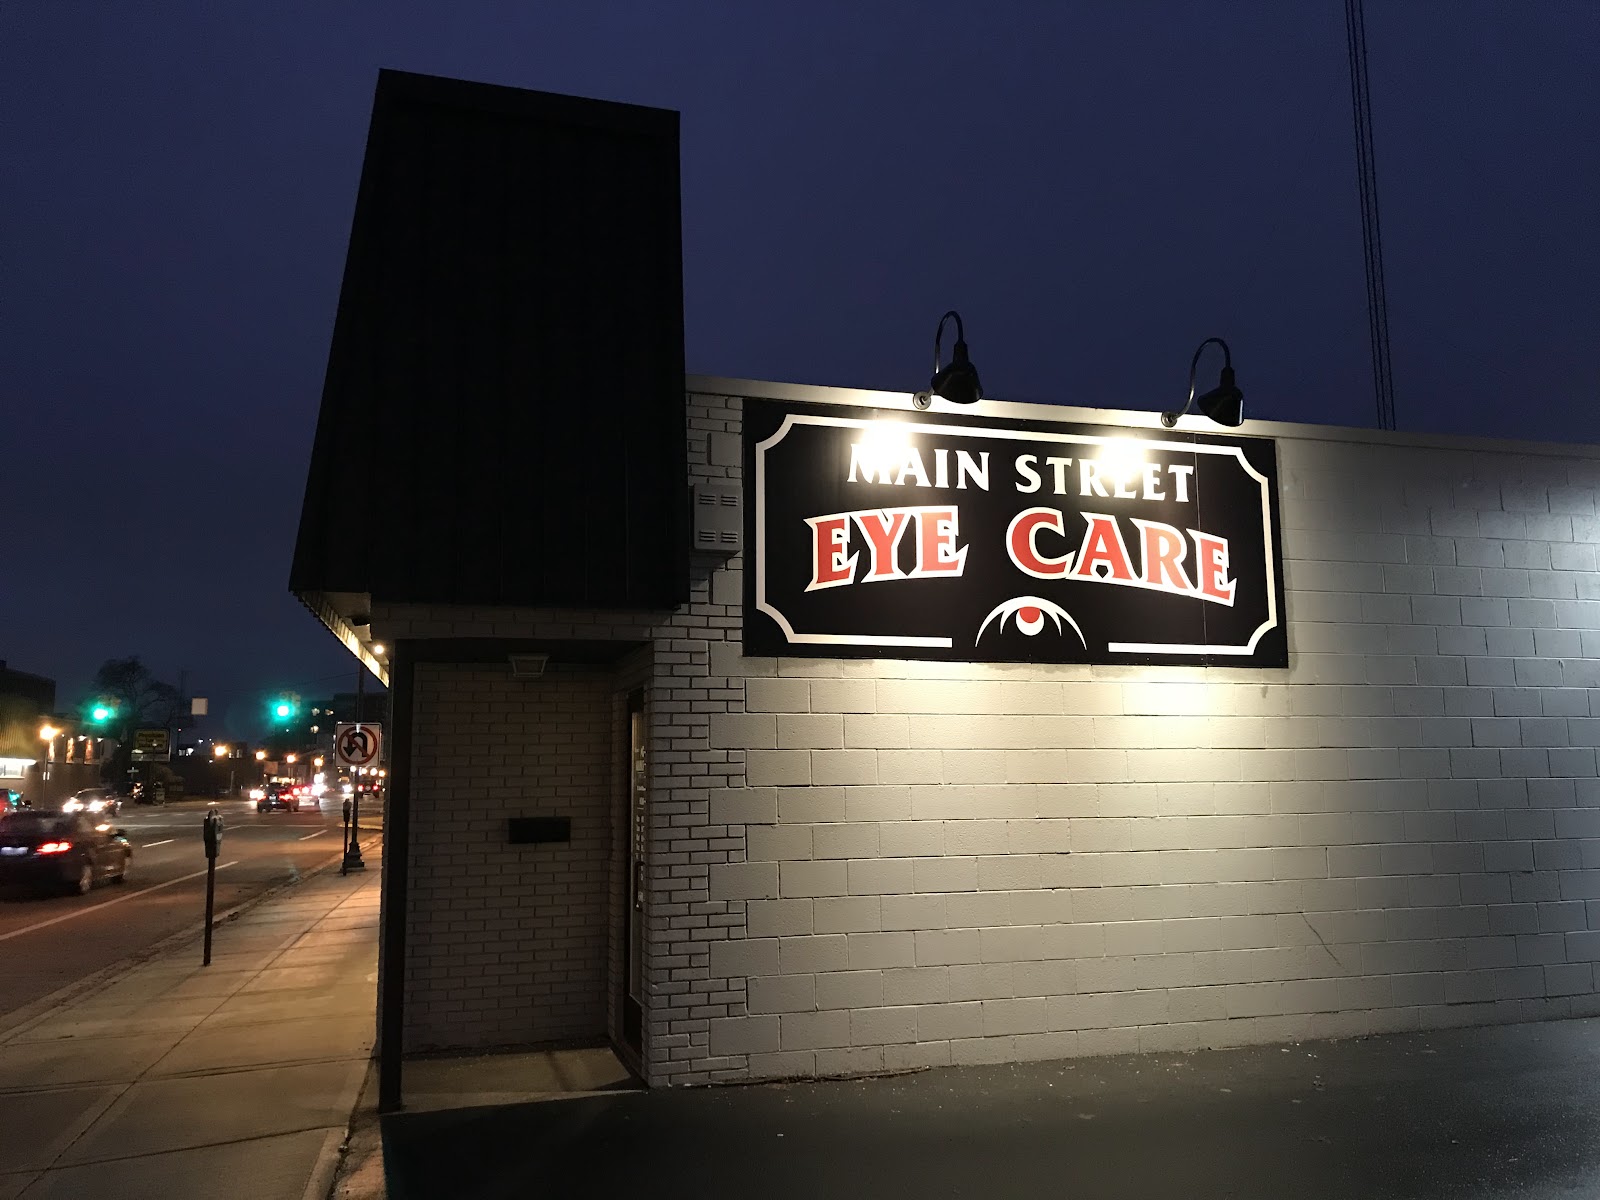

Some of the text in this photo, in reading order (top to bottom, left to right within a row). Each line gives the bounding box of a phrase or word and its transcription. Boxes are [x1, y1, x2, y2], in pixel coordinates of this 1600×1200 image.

[847, 443, 1194, 502] MAIN STREET
[803, 505, 1237, 607] EYE CARE
